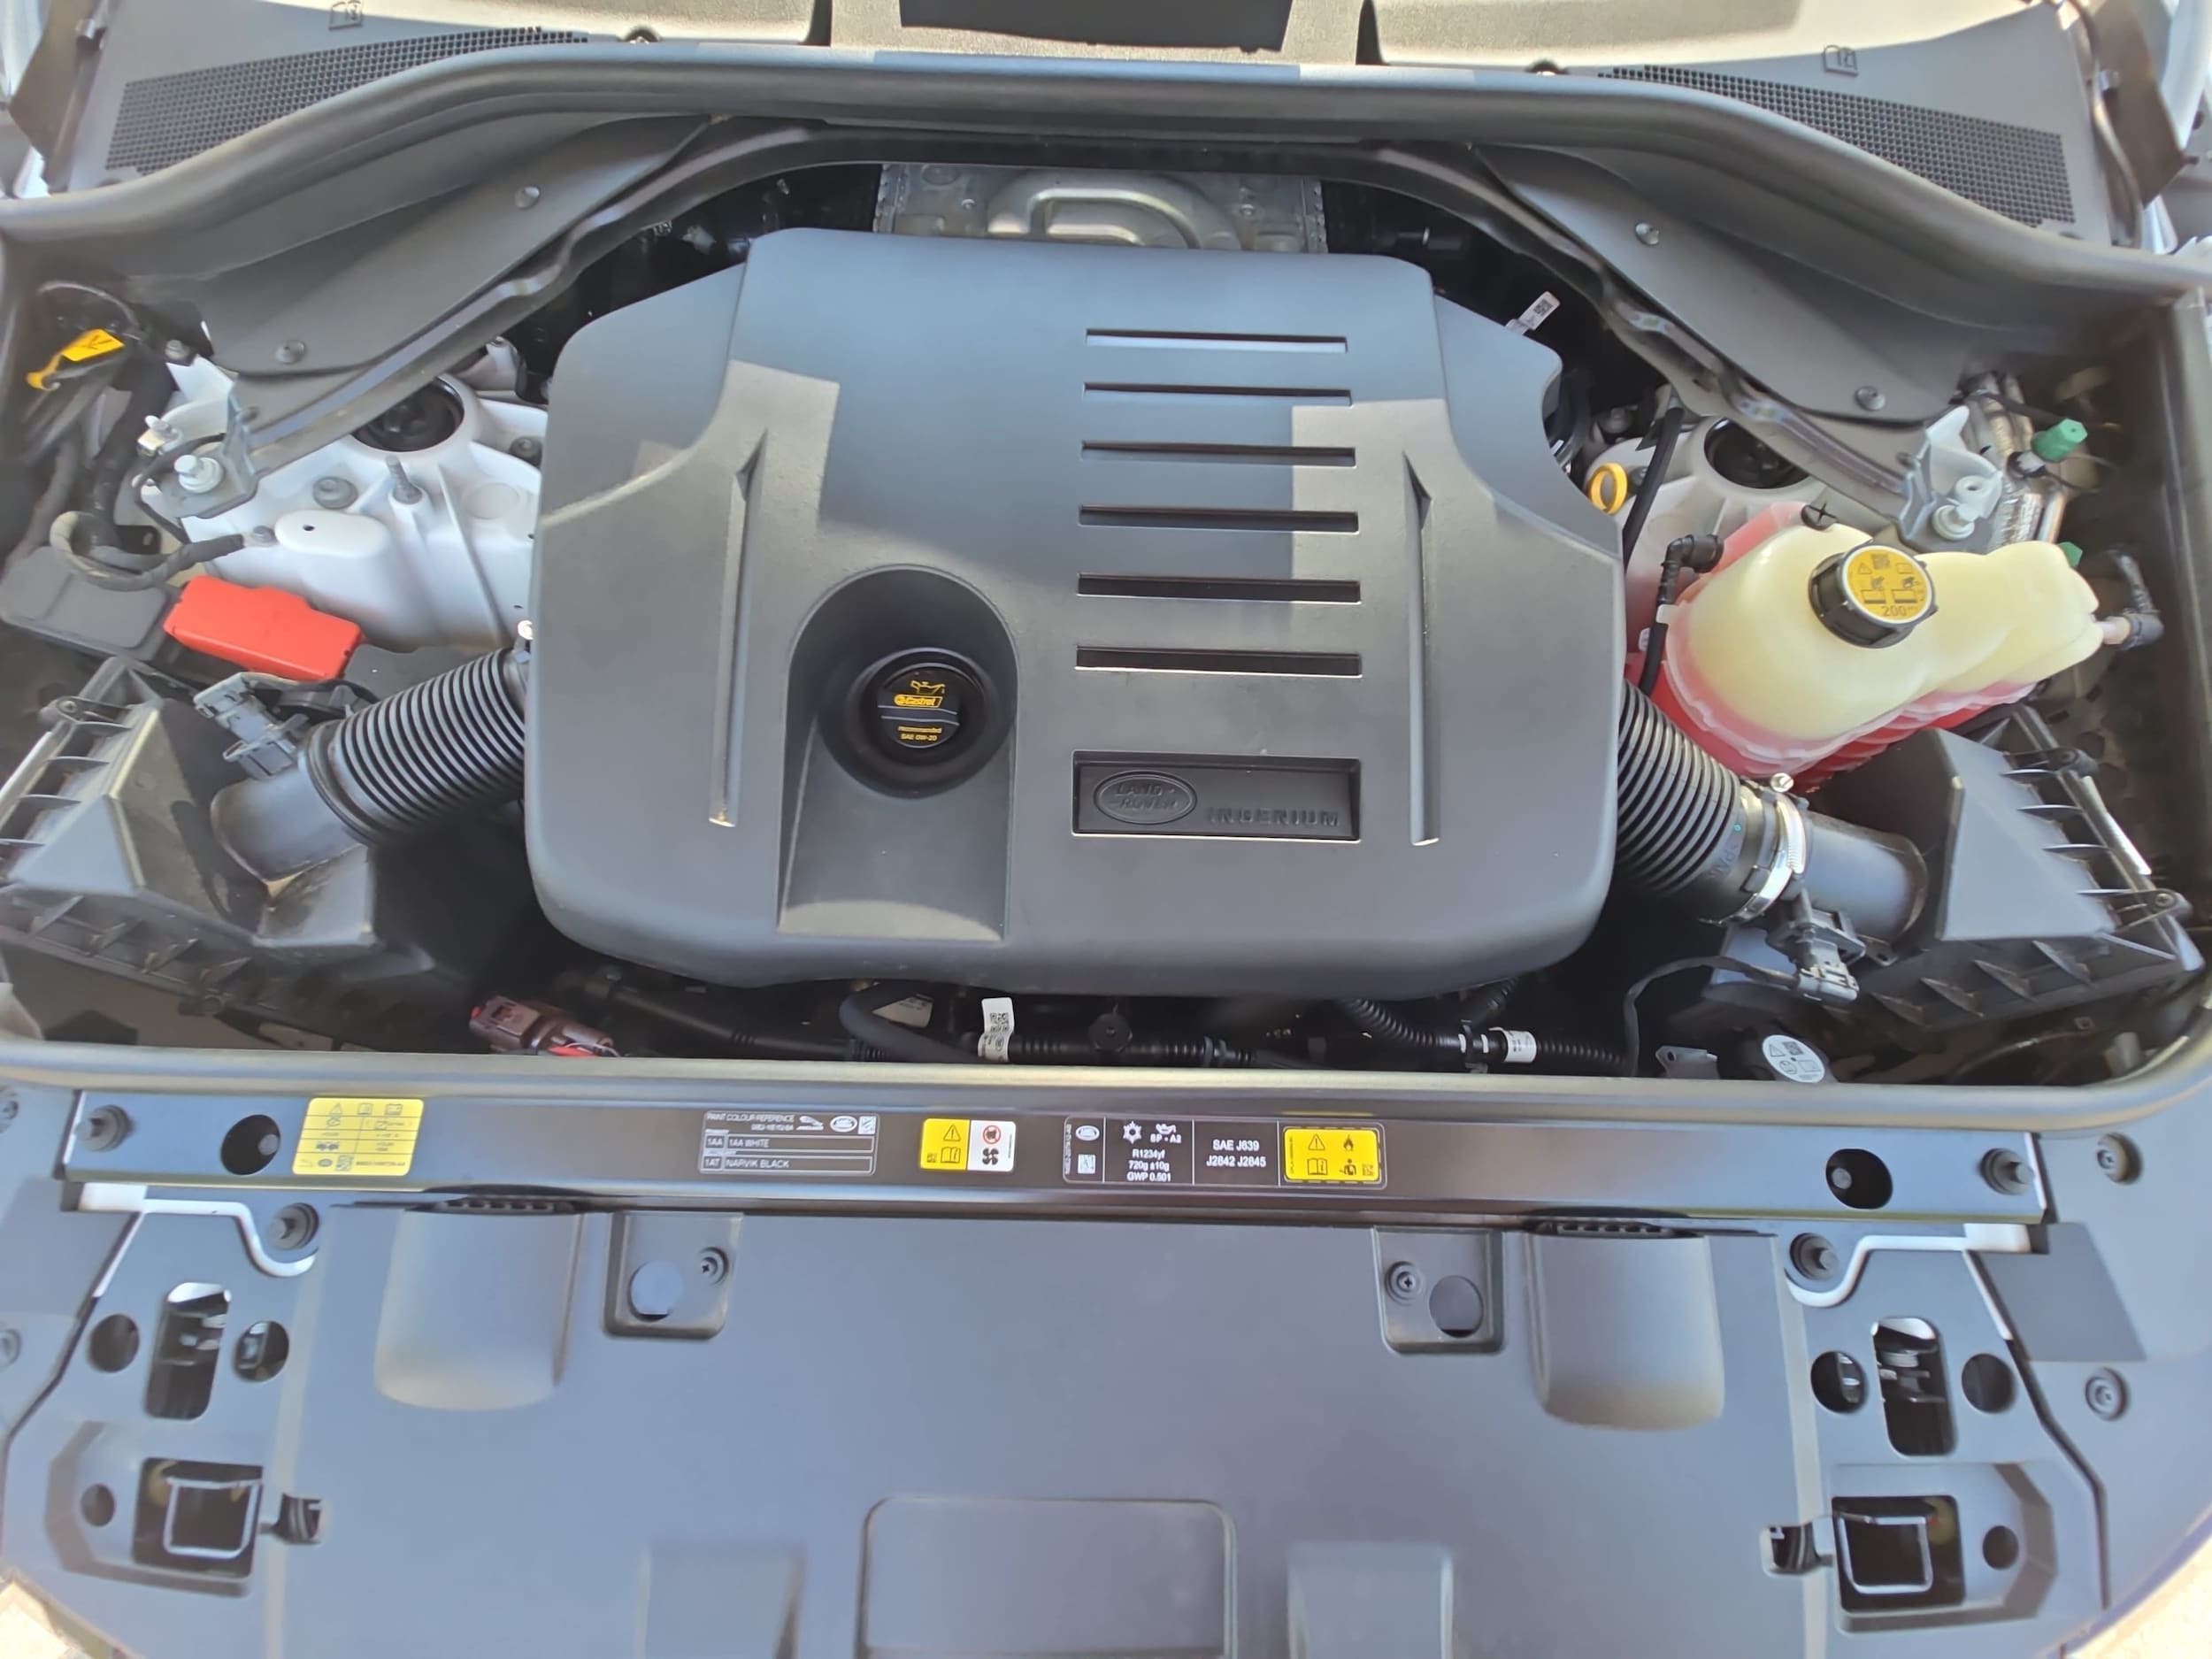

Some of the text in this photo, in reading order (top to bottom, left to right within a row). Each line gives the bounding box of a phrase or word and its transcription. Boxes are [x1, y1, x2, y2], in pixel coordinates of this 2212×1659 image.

[1882, 605, 1908, 617] 200
[905, 696, 937, 706] Castrol
[1207, 806, 1340, 827] INGENIUM
[707, 1137, 723, 1146] 1AA
[745, 1139, 770, 1148] WHITE
[1212, 1139, 1260, 1151] SAE J639
[1132, 1148, 1165, 1160] R1234yf
[705, 1157, 720, 1167] 1AT
[726, 1158, 789, 1169] NARVIK BLACK
[1128, 1160, 1148, 1171] 720g
[1206, 1155, 1266, 1168] J2842 J2845
[1126, 1171, 1148, 1181] GWP
